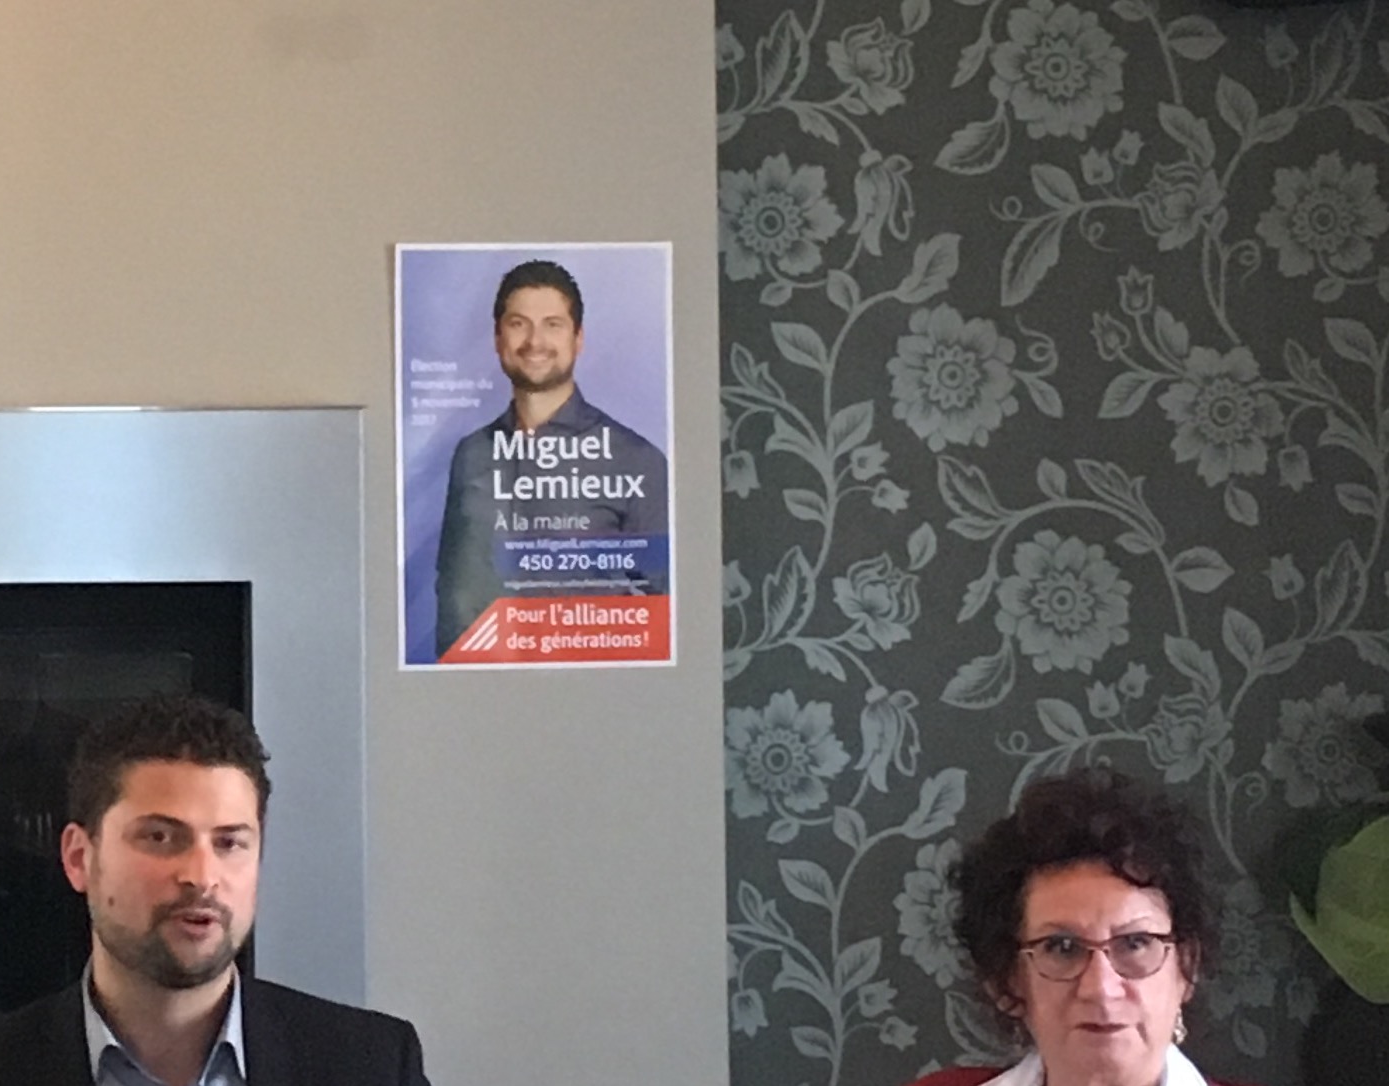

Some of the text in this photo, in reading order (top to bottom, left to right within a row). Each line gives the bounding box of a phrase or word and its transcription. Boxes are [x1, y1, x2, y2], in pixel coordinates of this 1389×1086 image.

[492, 427, 613, 469] Miguel
[493, 468, 645, 500] Lemieux
[494, 510, 590, 531] À la mairie
[519, 553, 635, 571] 450 270-8116
[506, 603, 649, 625] Pour l'alliance
[506, 632, 536, 650] des
